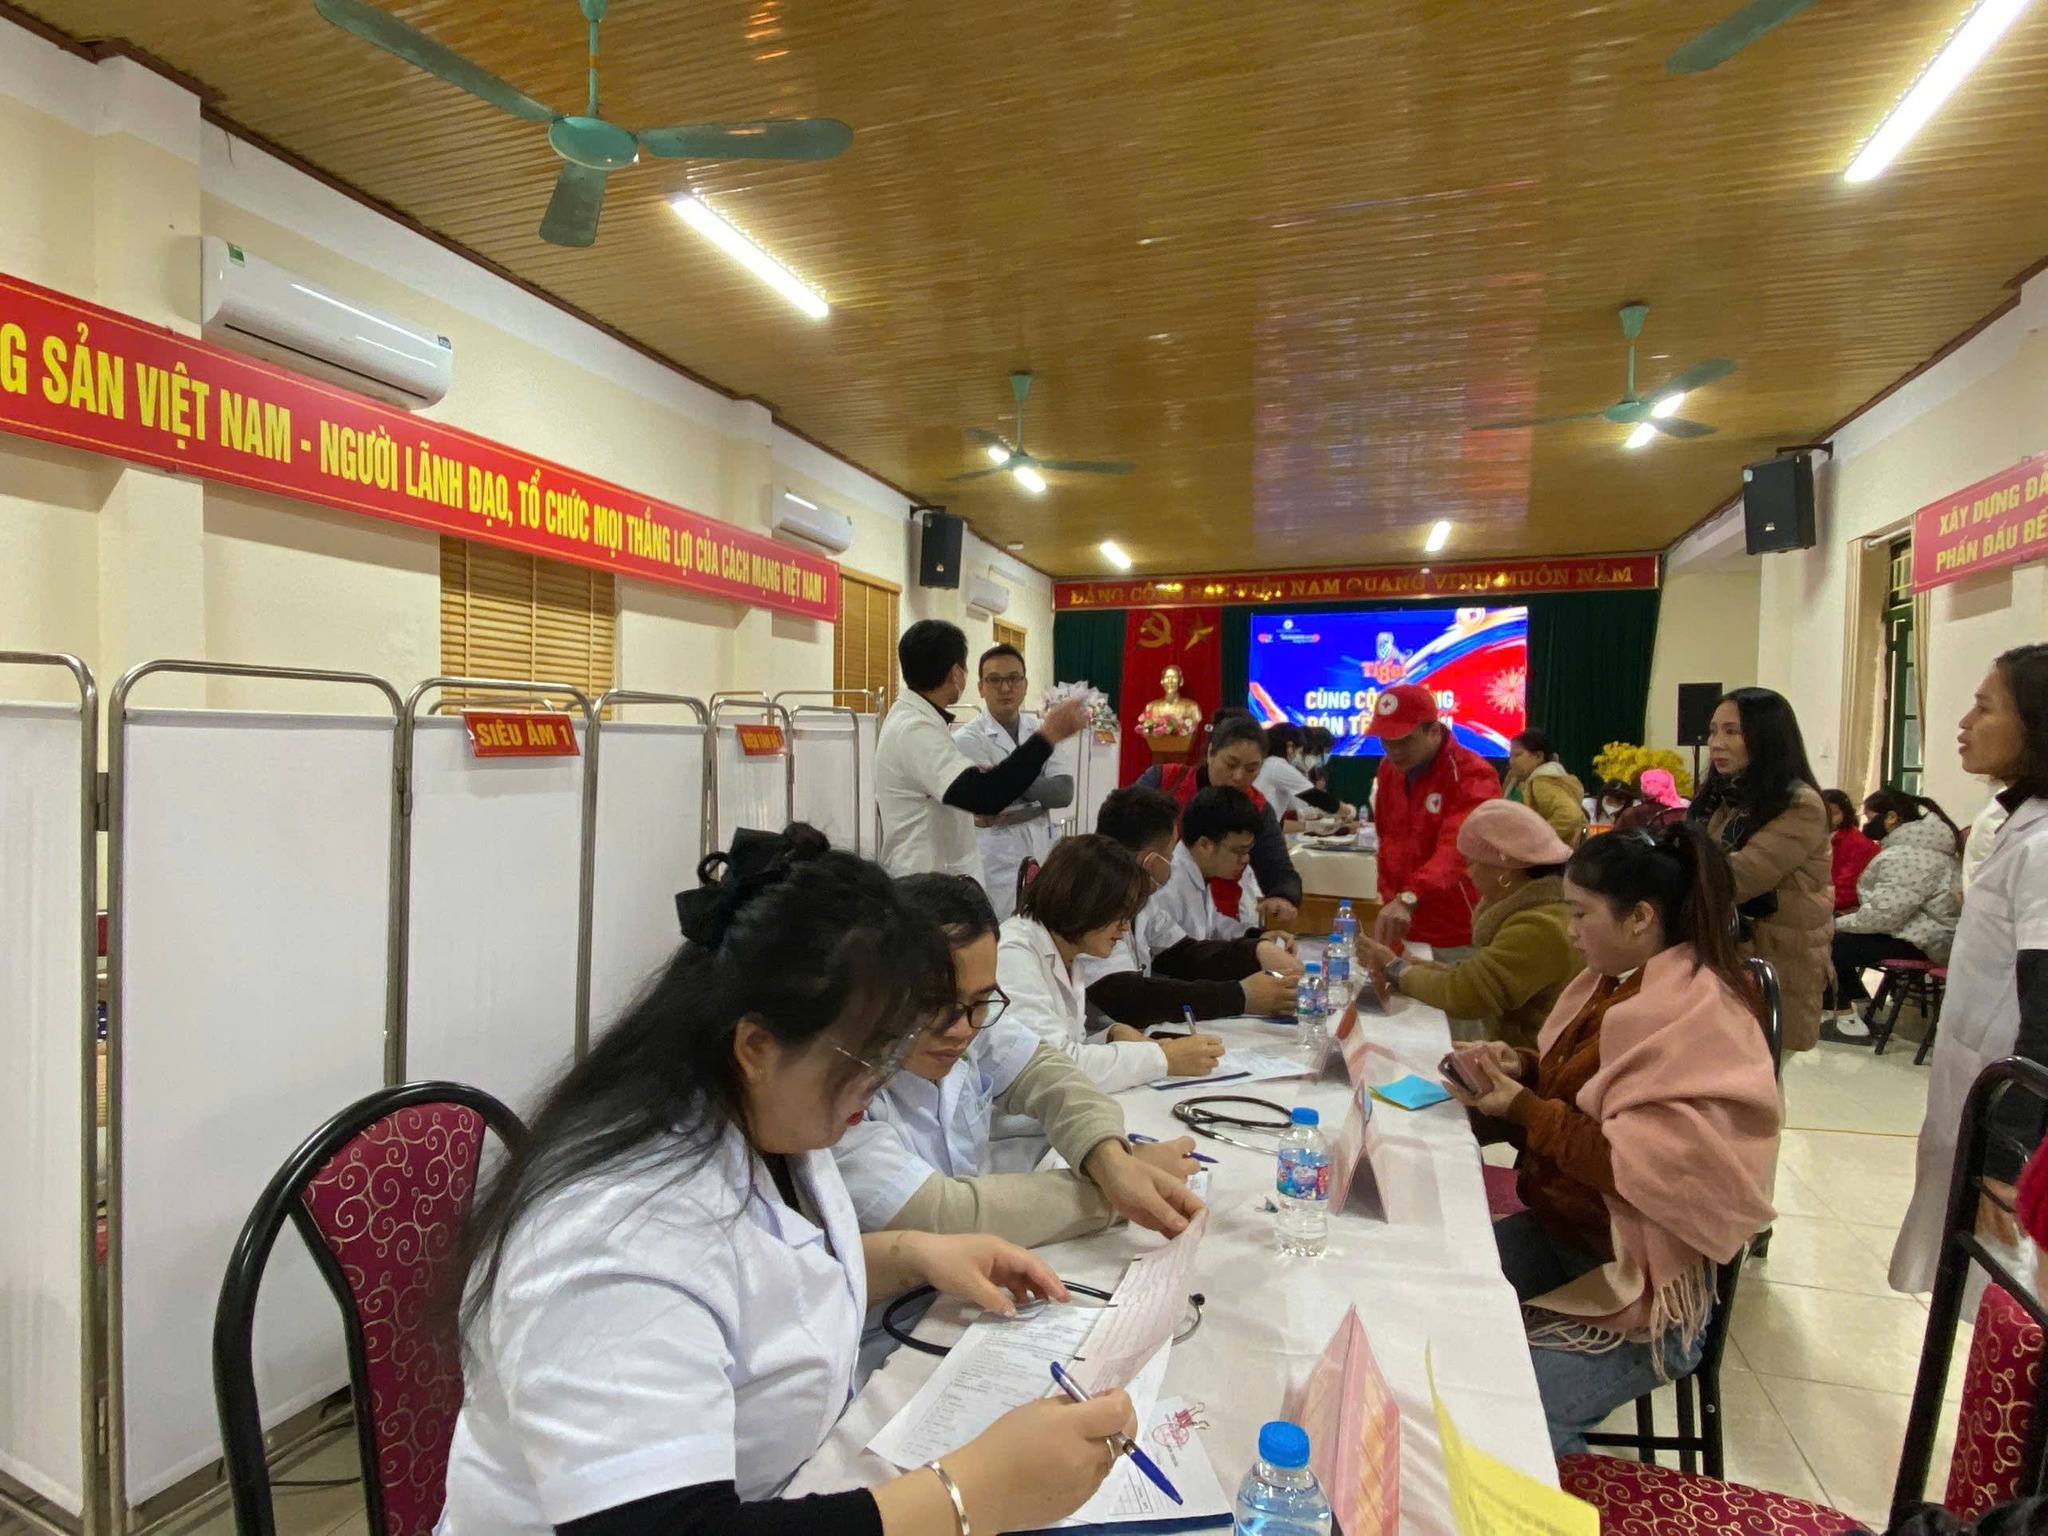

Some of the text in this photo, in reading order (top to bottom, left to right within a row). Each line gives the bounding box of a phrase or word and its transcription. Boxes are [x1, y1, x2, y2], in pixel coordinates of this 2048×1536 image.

[42, 322, 125, 420] SẢN
[135, 362, 210, 450] VIỆT
[220, 388, 292, 464] NAM
[320, 420, 399, 492] NGƯỜI
[405, 440, 463, 509] LÃNH
[468, 465, 514, 528] ĐẠO,
[518, 468, 541, 530] TỔ
[545, 487, 590, 543] CHỨC
[594, 504, 623, 559] MỌI
[626, 506, 671, 564] THẮNG
[674, 529, 693, 577] LỢI
[696, 527, 719, 577] CỦA
[721, 539, 750, 585] CÁCH
[752, 553, 780, 597] MẠNG
[782, 559, 801, 604] VIỆT
[802, 569, 822, 604] NAM
[1939, 505, 1969, 537] XÂY
[1973, 484, 2020, 523] DỰNG
[1936, 535, 1979, 573] PHẤN
[1982, 519, 2019, 559] ĐẤU
[1290, 578, 1340, 597] NAM
[1305, 687, 1351, 710] CÙNG
[476, 719, 571, 746] SIÊU ÂM 1
